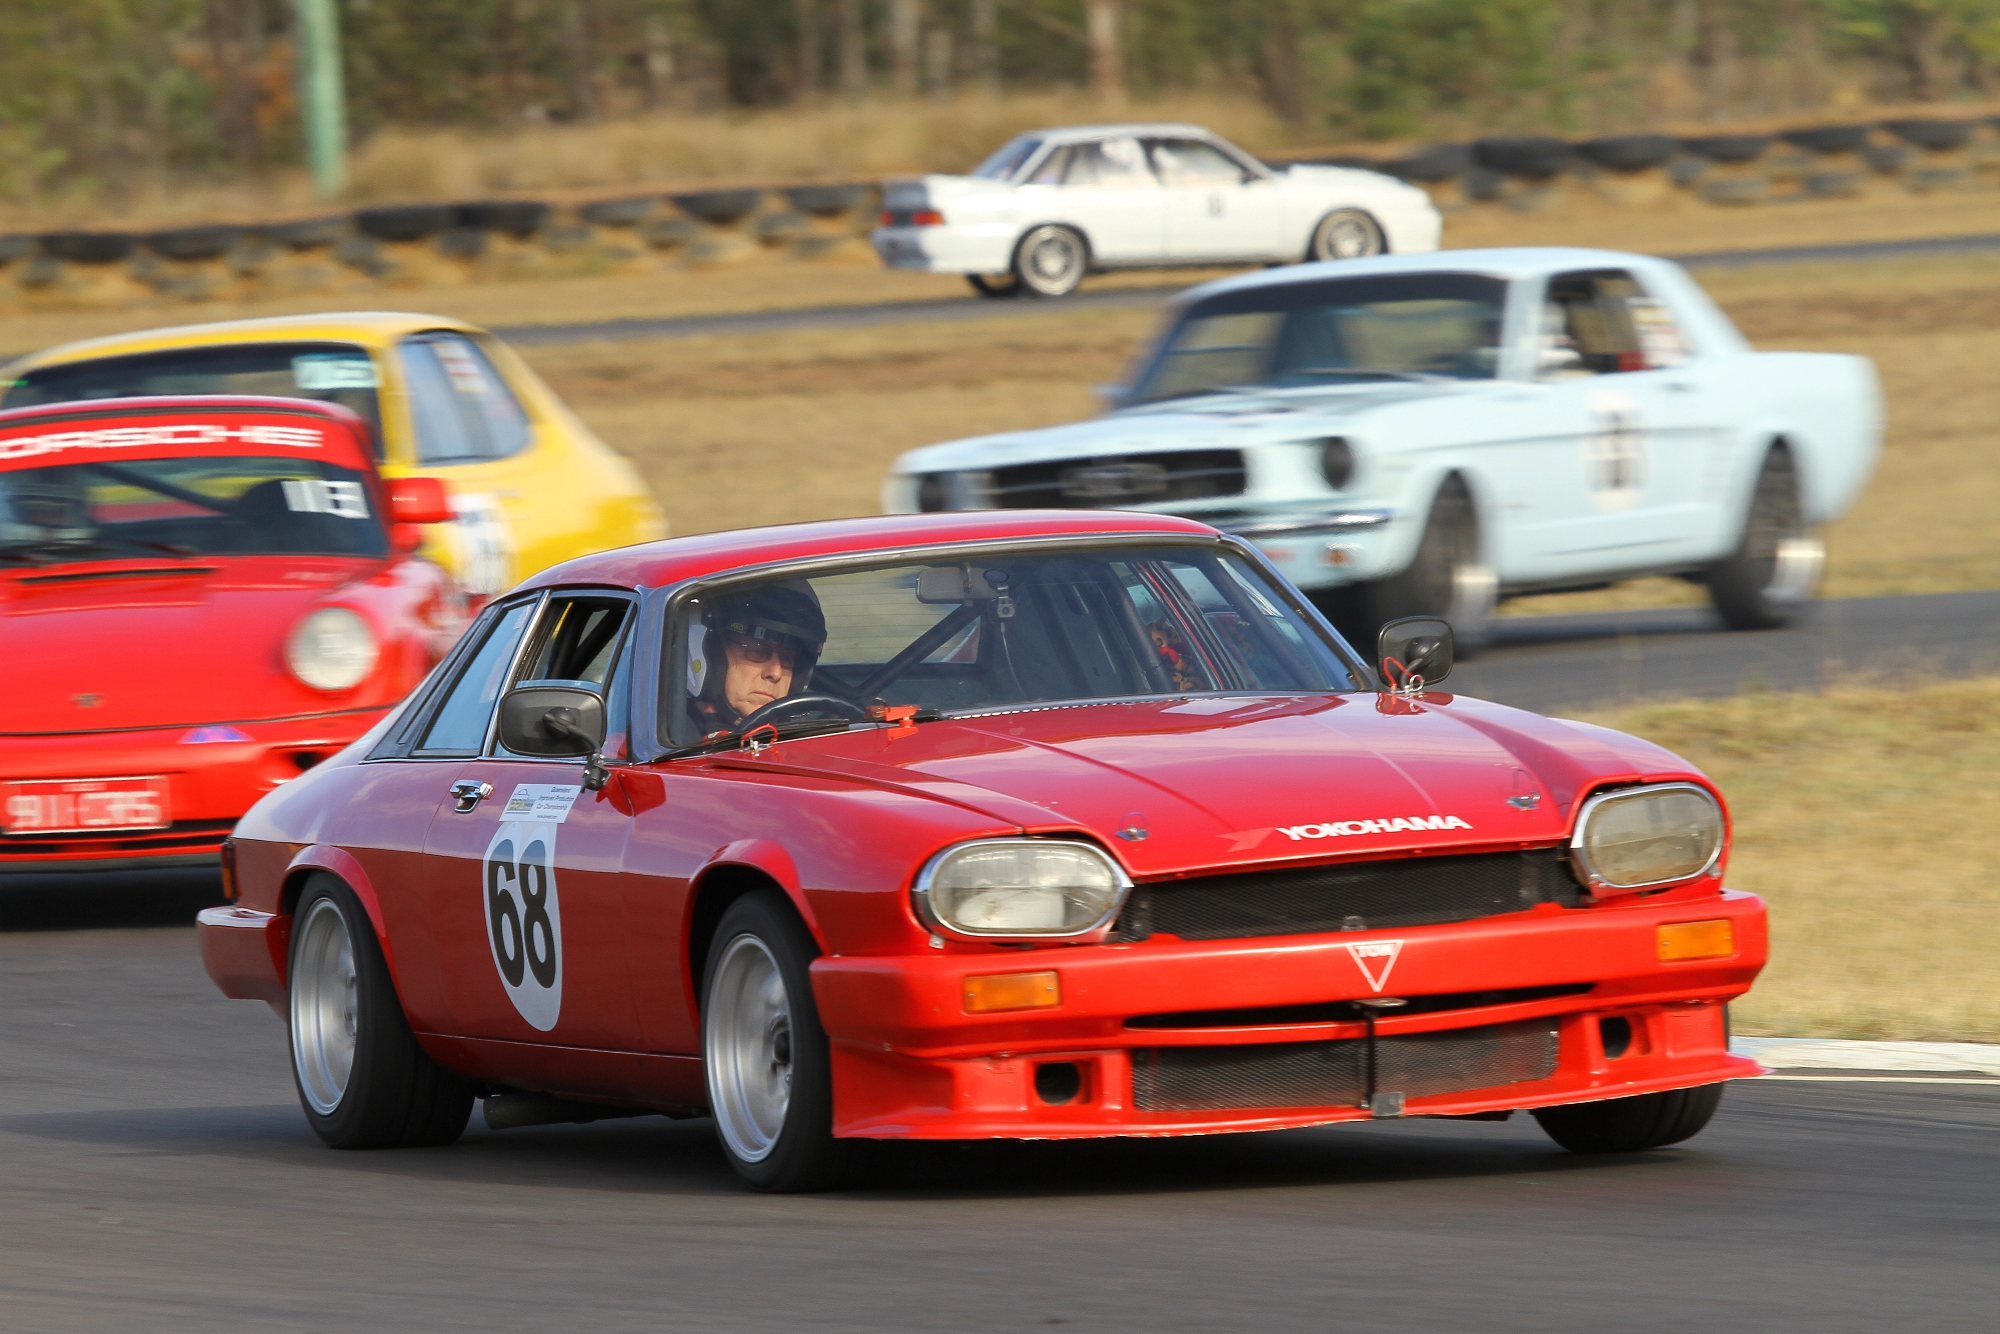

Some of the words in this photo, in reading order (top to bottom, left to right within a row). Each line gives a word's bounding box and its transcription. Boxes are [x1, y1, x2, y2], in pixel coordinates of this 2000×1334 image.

[1276, 815, 1473, 841] YOKOHAMA
[488, 839, 556, 988] 68
[1355, 944, 1395, 958] TOW
